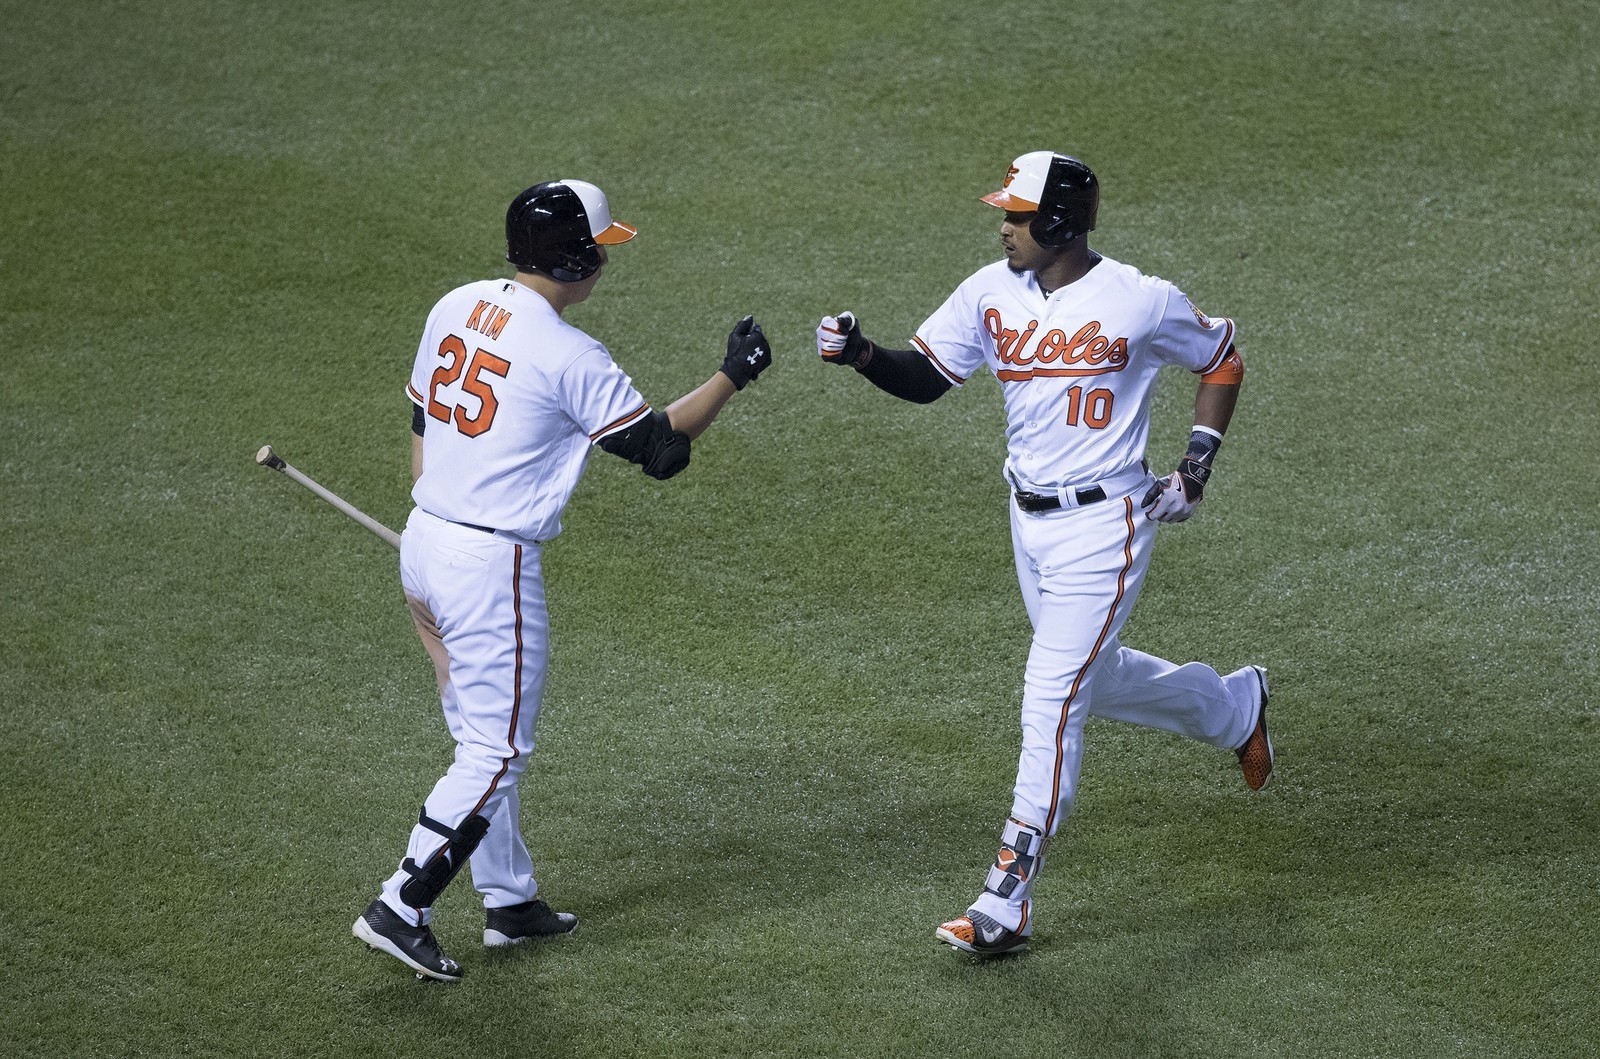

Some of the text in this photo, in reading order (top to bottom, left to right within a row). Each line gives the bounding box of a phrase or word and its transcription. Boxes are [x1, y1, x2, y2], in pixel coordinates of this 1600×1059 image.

[466, 300, 512, 341] KIM
[984, 308, 1129, 367] Orioles
[428, 334, 511, 438] 25
[1066, 386, 1115, 430] 10
